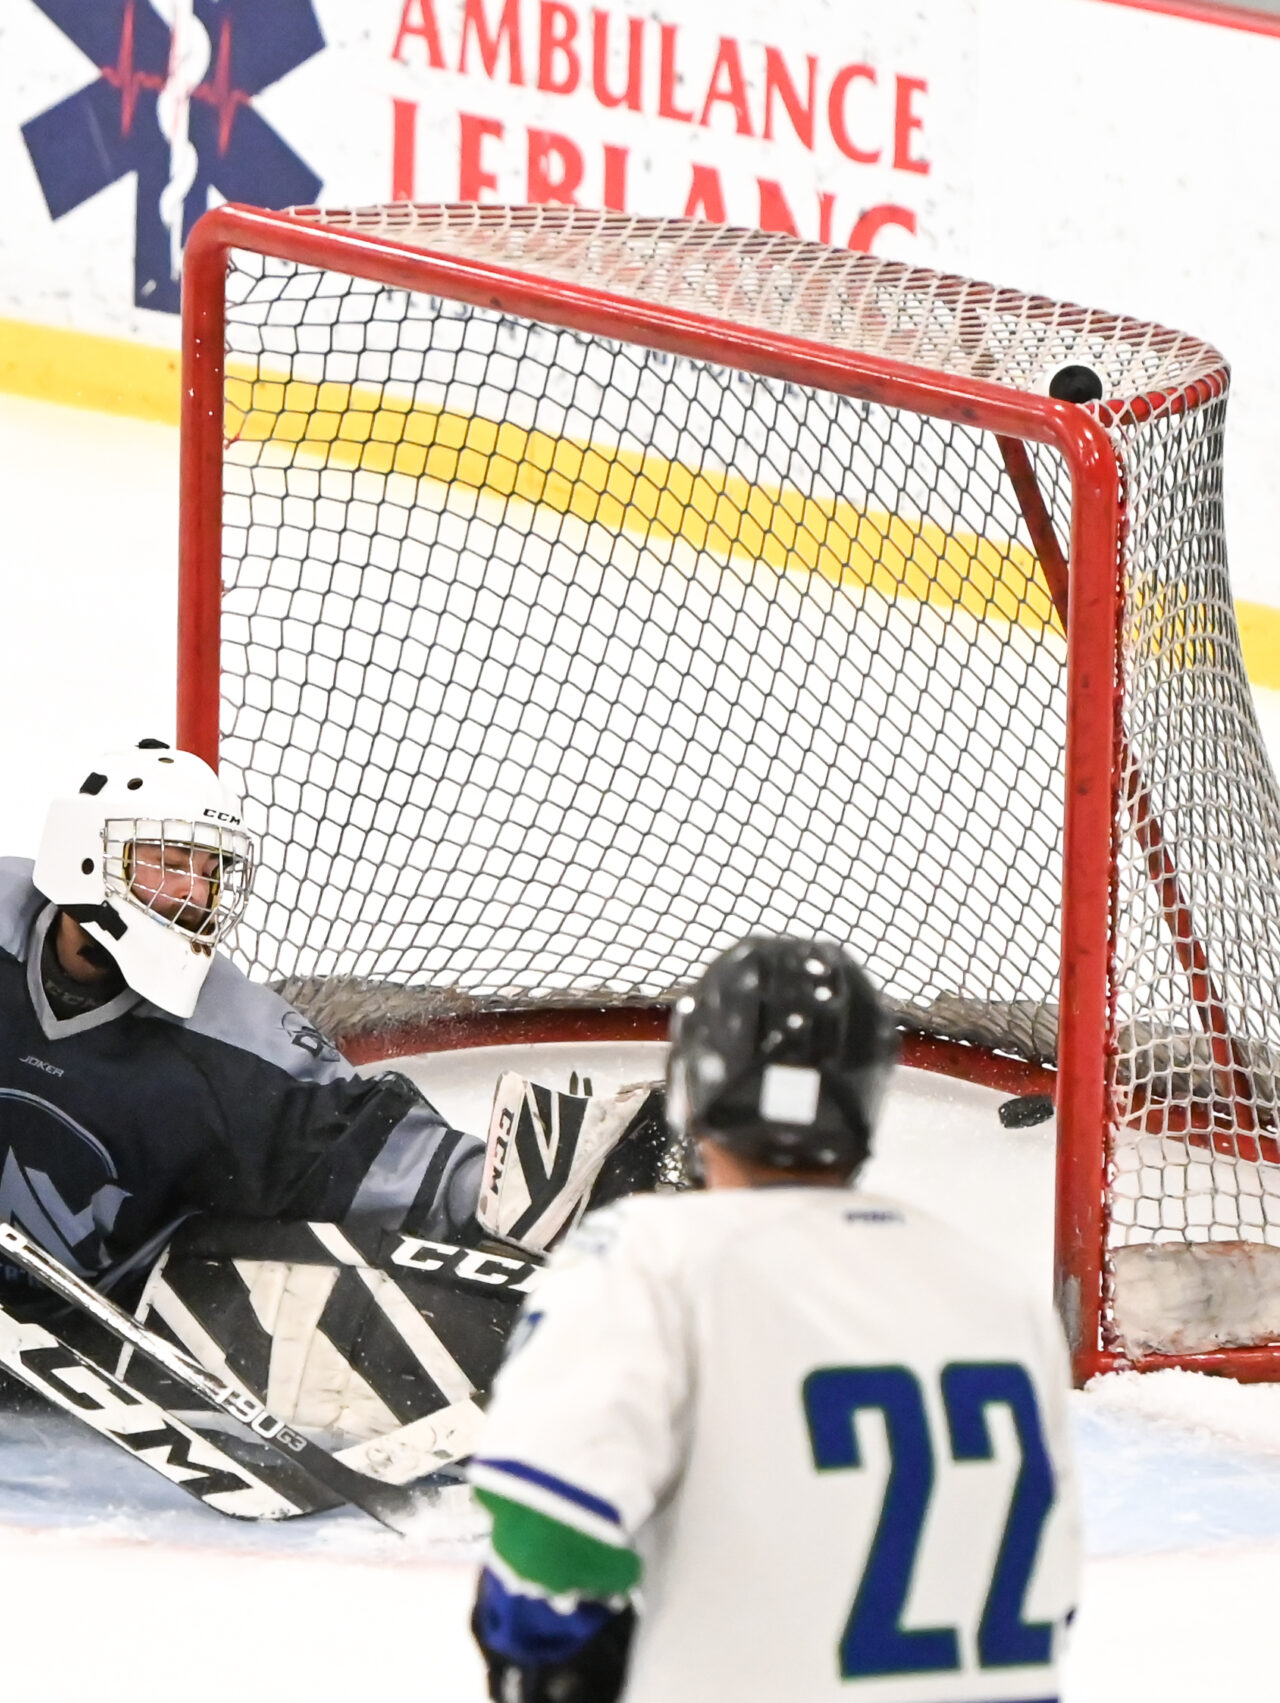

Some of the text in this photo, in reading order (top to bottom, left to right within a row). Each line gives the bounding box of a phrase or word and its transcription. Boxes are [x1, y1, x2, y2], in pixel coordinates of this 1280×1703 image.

[391, 0, 934, 176] AMBULANCE
[203, 808, 241, 826] CCM
[19, 1056, 64, 1077] JOKER
[490, 1107, 515, 1196] CCM
[276, 1429, 308, 1452] G3
[802, 1361, 1060, 1680] 22
